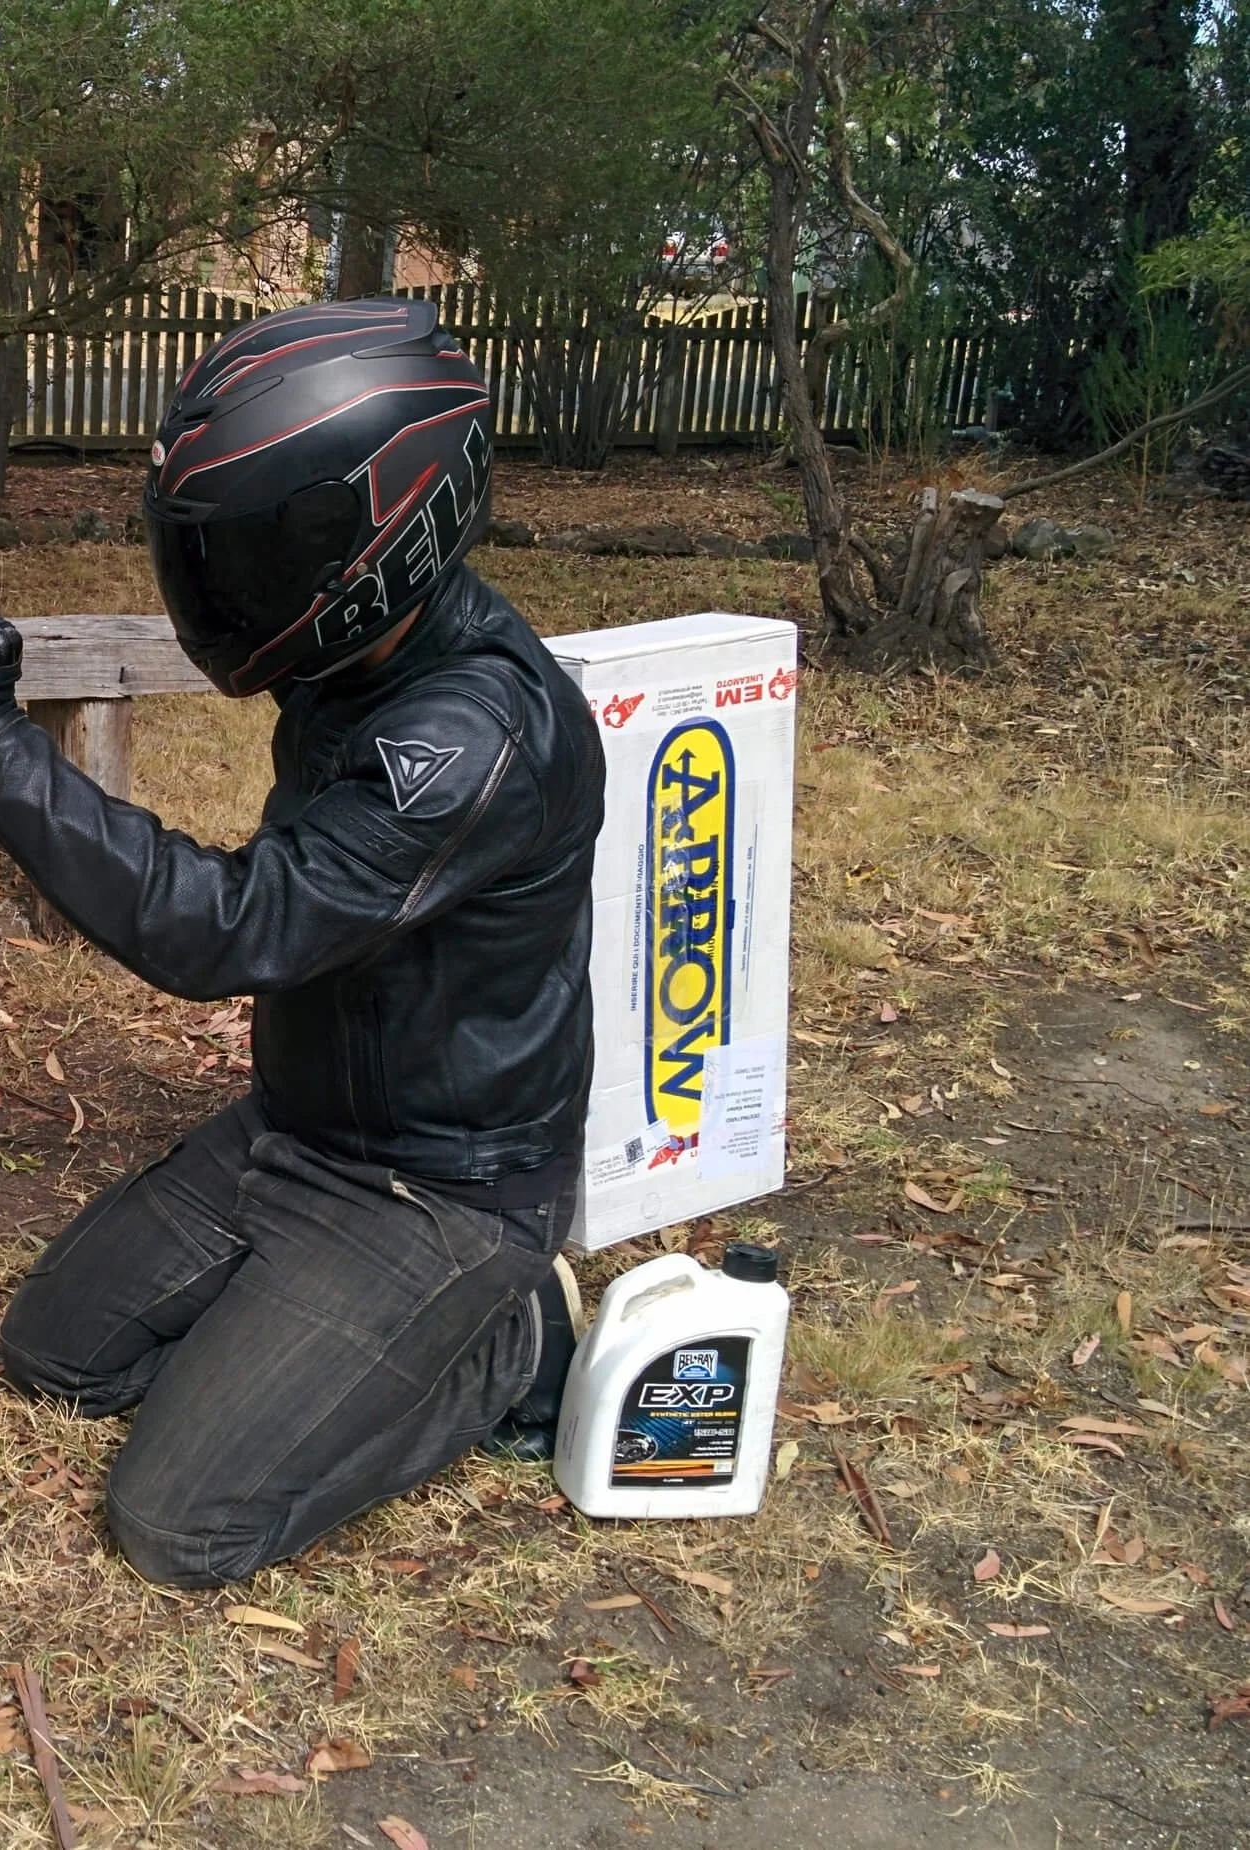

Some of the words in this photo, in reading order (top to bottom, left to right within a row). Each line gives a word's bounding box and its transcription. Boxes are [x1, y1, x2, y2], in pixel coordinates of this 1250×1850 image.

[315, 419, 492, 648] BELL
[715, 684, 763, 708] EM
[716, 673, 764, 688] LINEAMOTO
[636, 844, 645, 883] VIAGGIO
[633, 895, 642, 947] DOCUMENTI
[659, 750, 720, 1101] ARROW
[630, 970, 639, 1012] INSERIRE
[638, 1384, 735, 1408] EXP
